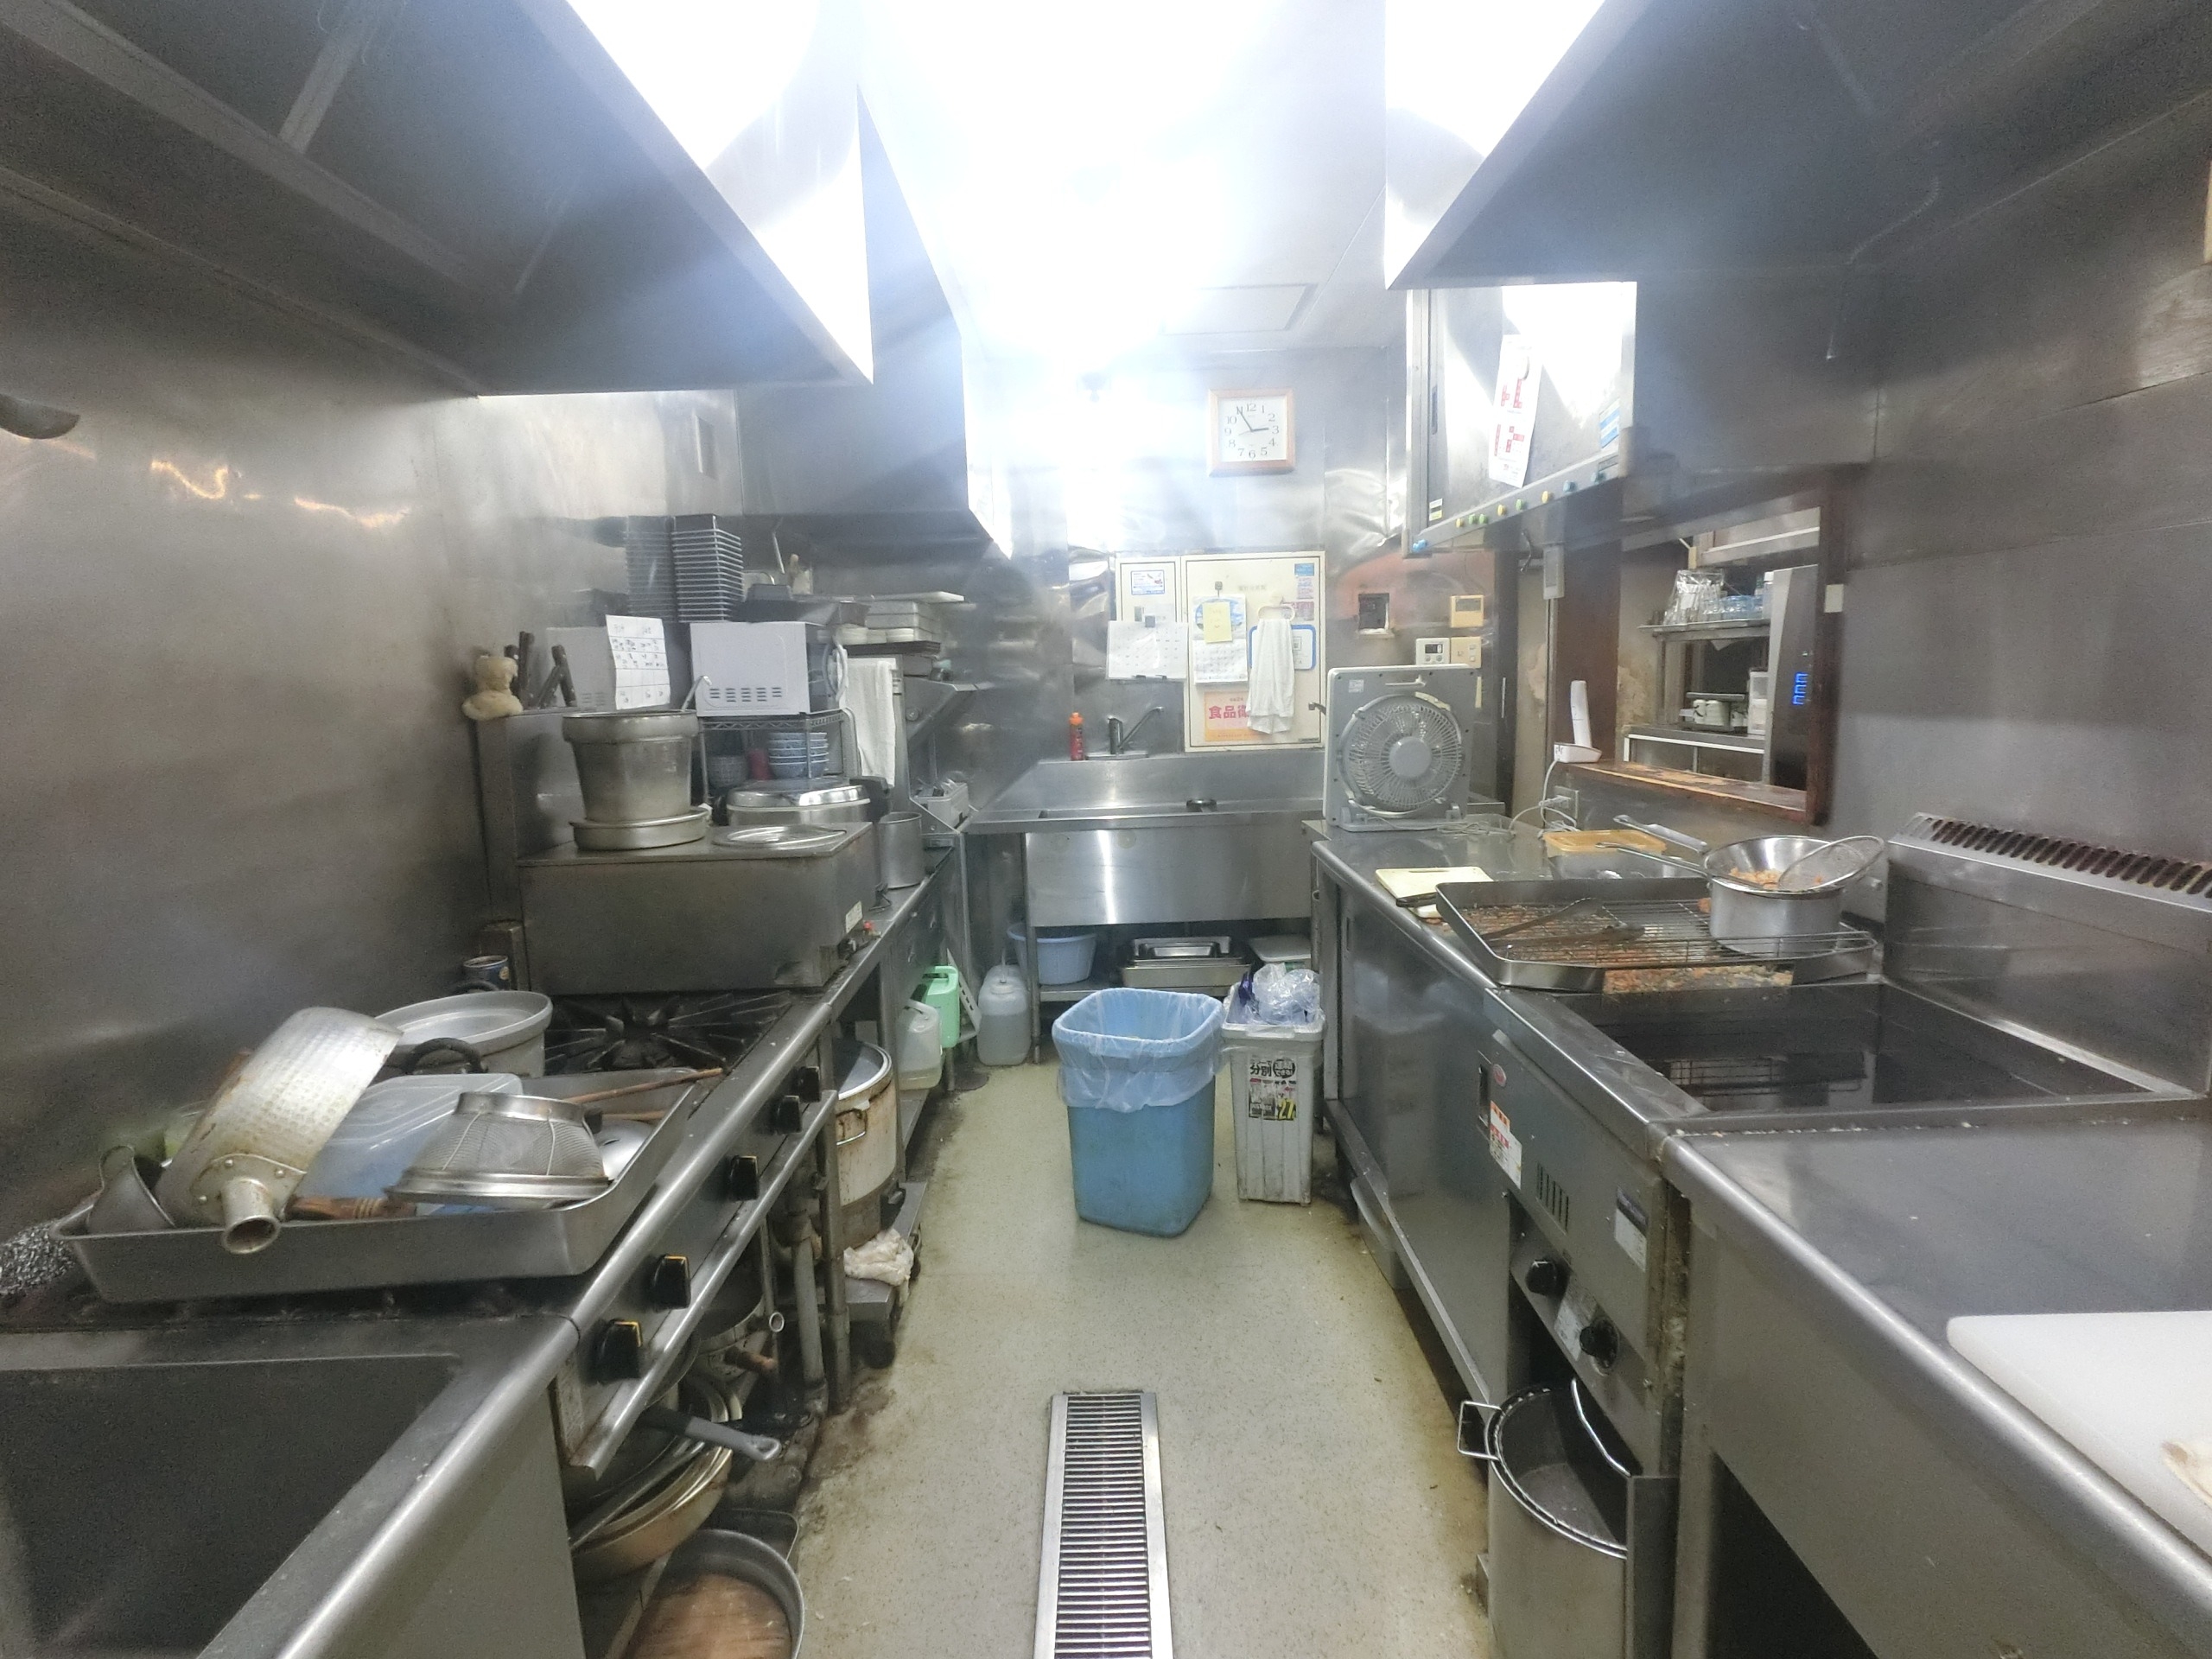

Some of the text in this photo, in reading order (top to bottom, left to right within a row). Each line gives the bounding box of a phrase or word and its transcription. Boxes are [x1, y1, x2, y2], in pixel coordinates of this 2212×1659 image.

[1247, 404, 1256, 412] 12
[1262, 404, 1265, 414] 1
[1227, 416, 1237, 424] 10
[1268, 413, 1275, 422] 2
[1224, 428, 1232, 436] 9
[1272, 425, 1279, 435] 3
[1229, 439, 1236, 448] 8
[1268, 438, 1276, 447] 4
[1238, 448, 1245, 457] 7
[1249, 449, 1256, 459] 6
[1261, 447, 1268, 456] 5
